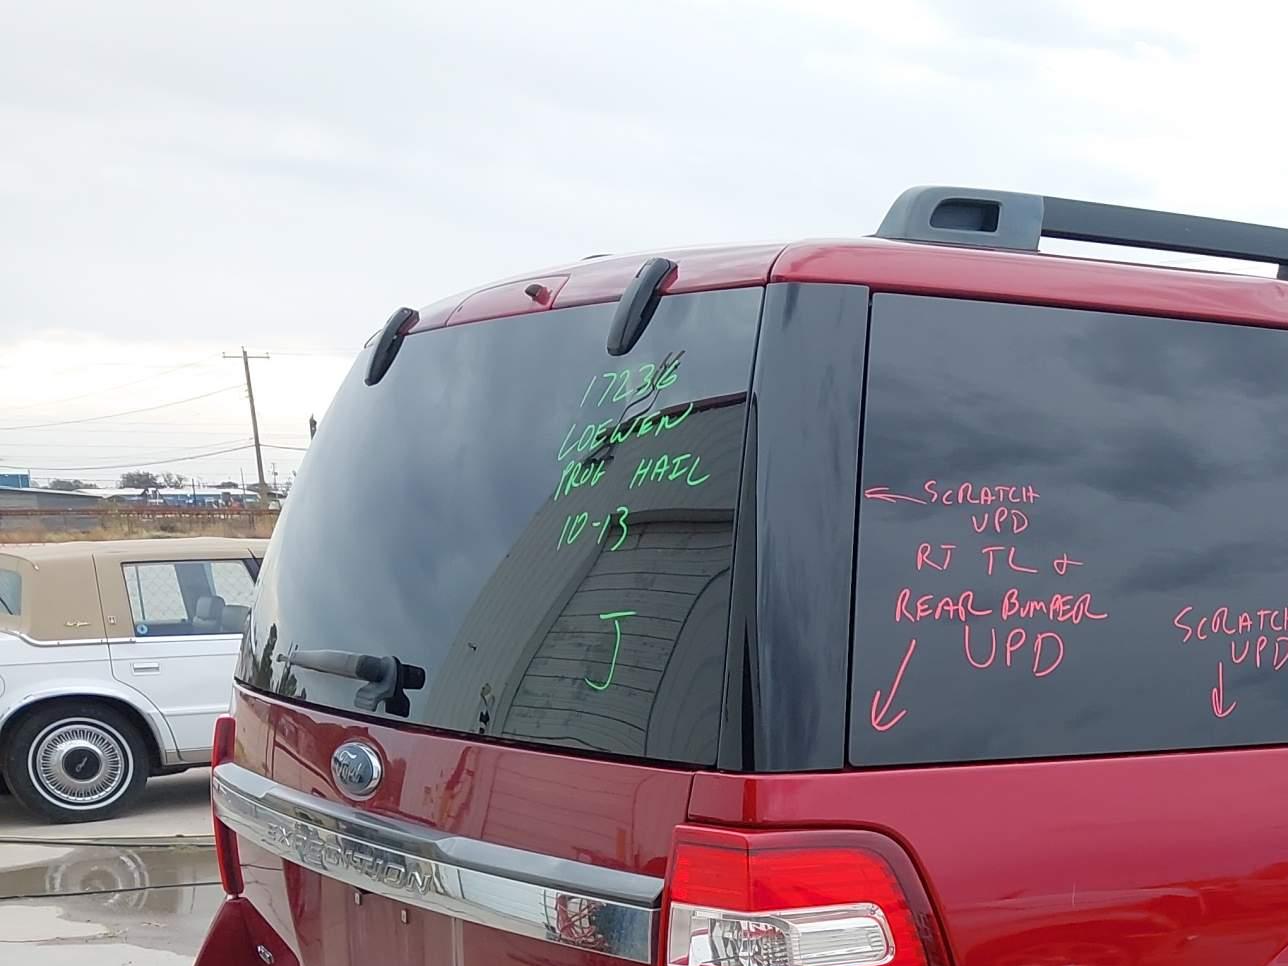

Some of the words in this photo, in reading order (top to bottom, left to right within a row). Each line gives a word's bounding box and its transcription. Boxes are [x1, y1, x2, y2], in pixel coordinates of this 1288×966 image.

[580, 359, 678, 407] 17236
[628, 453, 711, 489] HAIL
[924, 480, 1040, 505] SCRATCH
[556, 506, 629, 551] 10-13
[972, 506, 1029, 534] UPD
[916, 542, 957, 571] RT
[981, 546, 1039, 576] TL
[895, 588, 993, 623] REAR
[1001, 587, 1109, 625] BUMPER
[584, 611, 637, 690] J
[964, 624, 1064, 676] UPD
